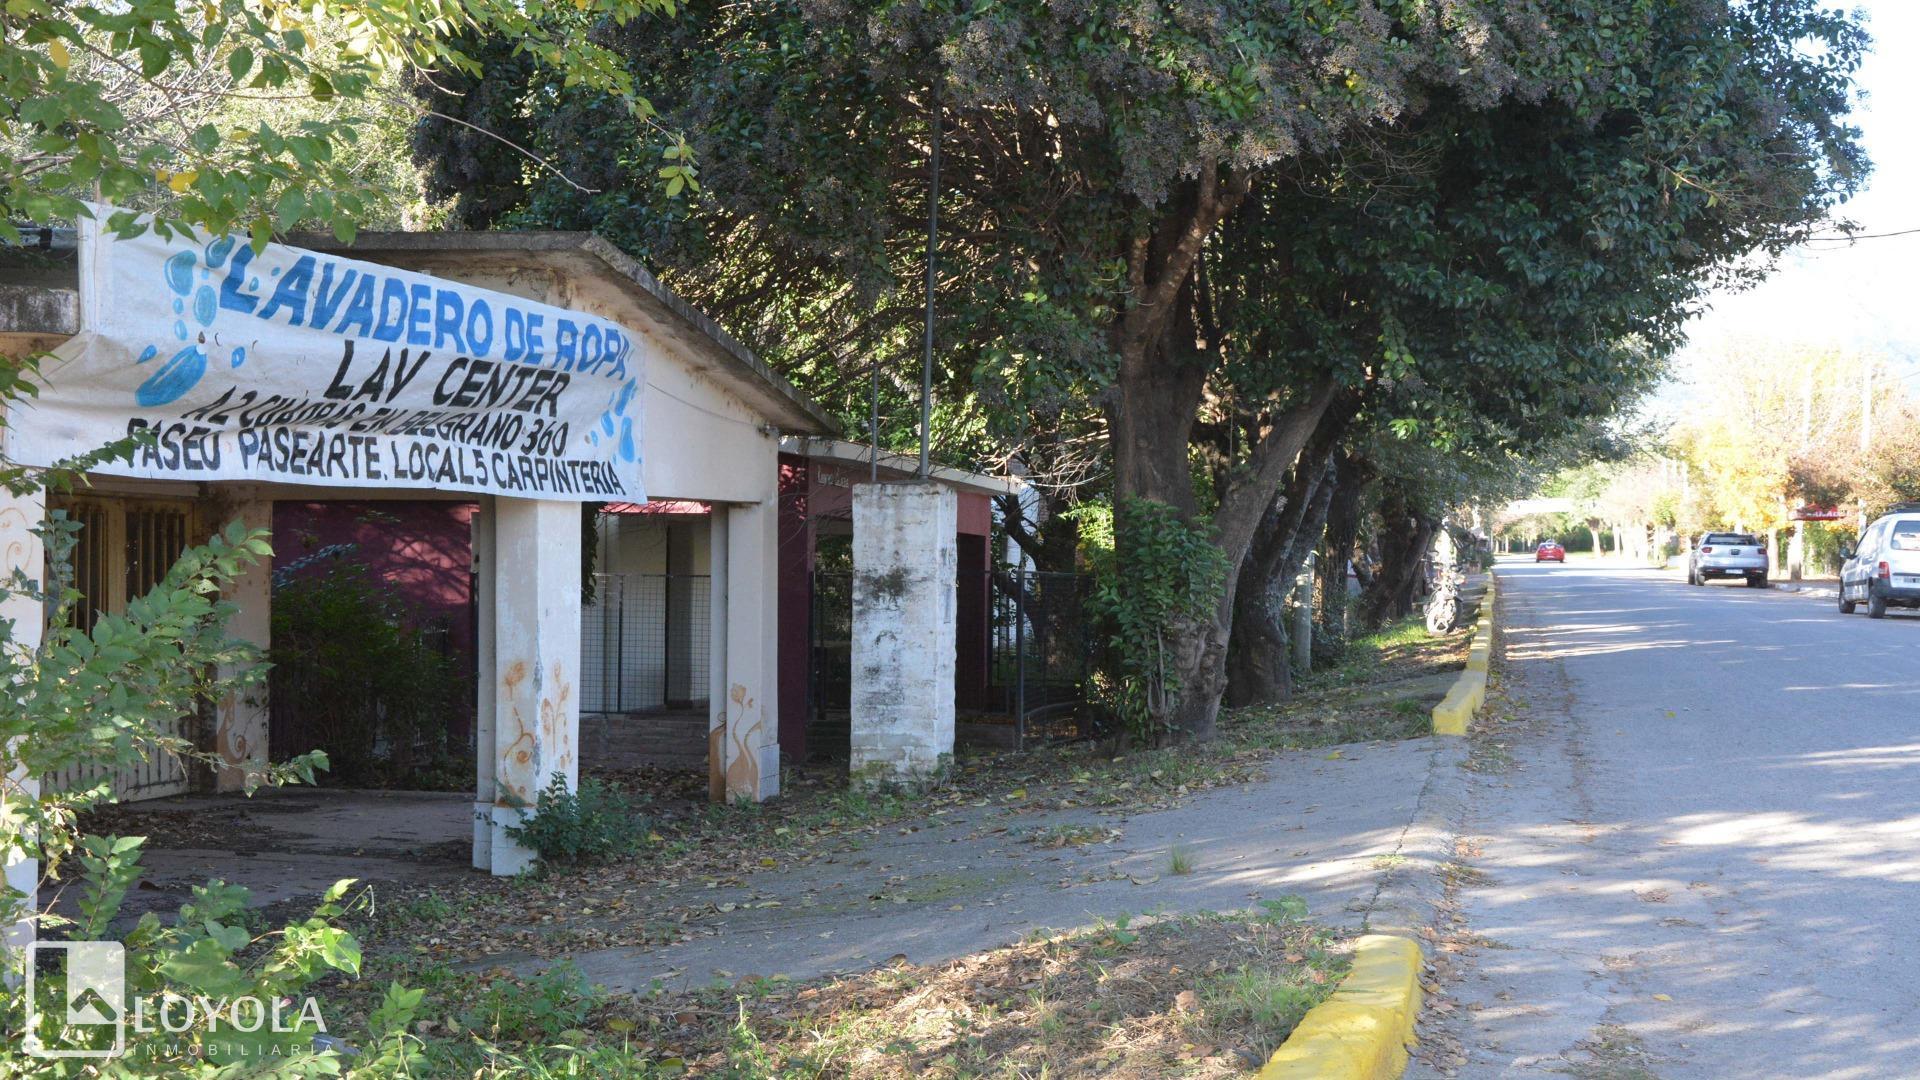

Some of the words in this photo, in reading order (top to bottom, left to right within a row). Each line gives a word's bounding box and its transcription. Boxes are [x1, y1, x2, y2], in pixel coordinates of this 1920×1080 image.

[219, 244, 493, 357] LAVADERO
[504, 308, 544, 365] DE
[551, 318, 630, 381] ROPA
[323, 339, 431, 404] LAV
[432, 357, 571, 417] CENTER
[181, 386, 237, 421] A
[208, 391, 258, 425] 2
[349, 407, 408, 433] EN
[388, 410, 523, 451] BELGRANO
[520, 418, 568, 457] 360
[391, 441, 474, 485] LOCAL
[472, 449, 488, 486] 5
[492, 452, 626, 495] CARPINTERIA
